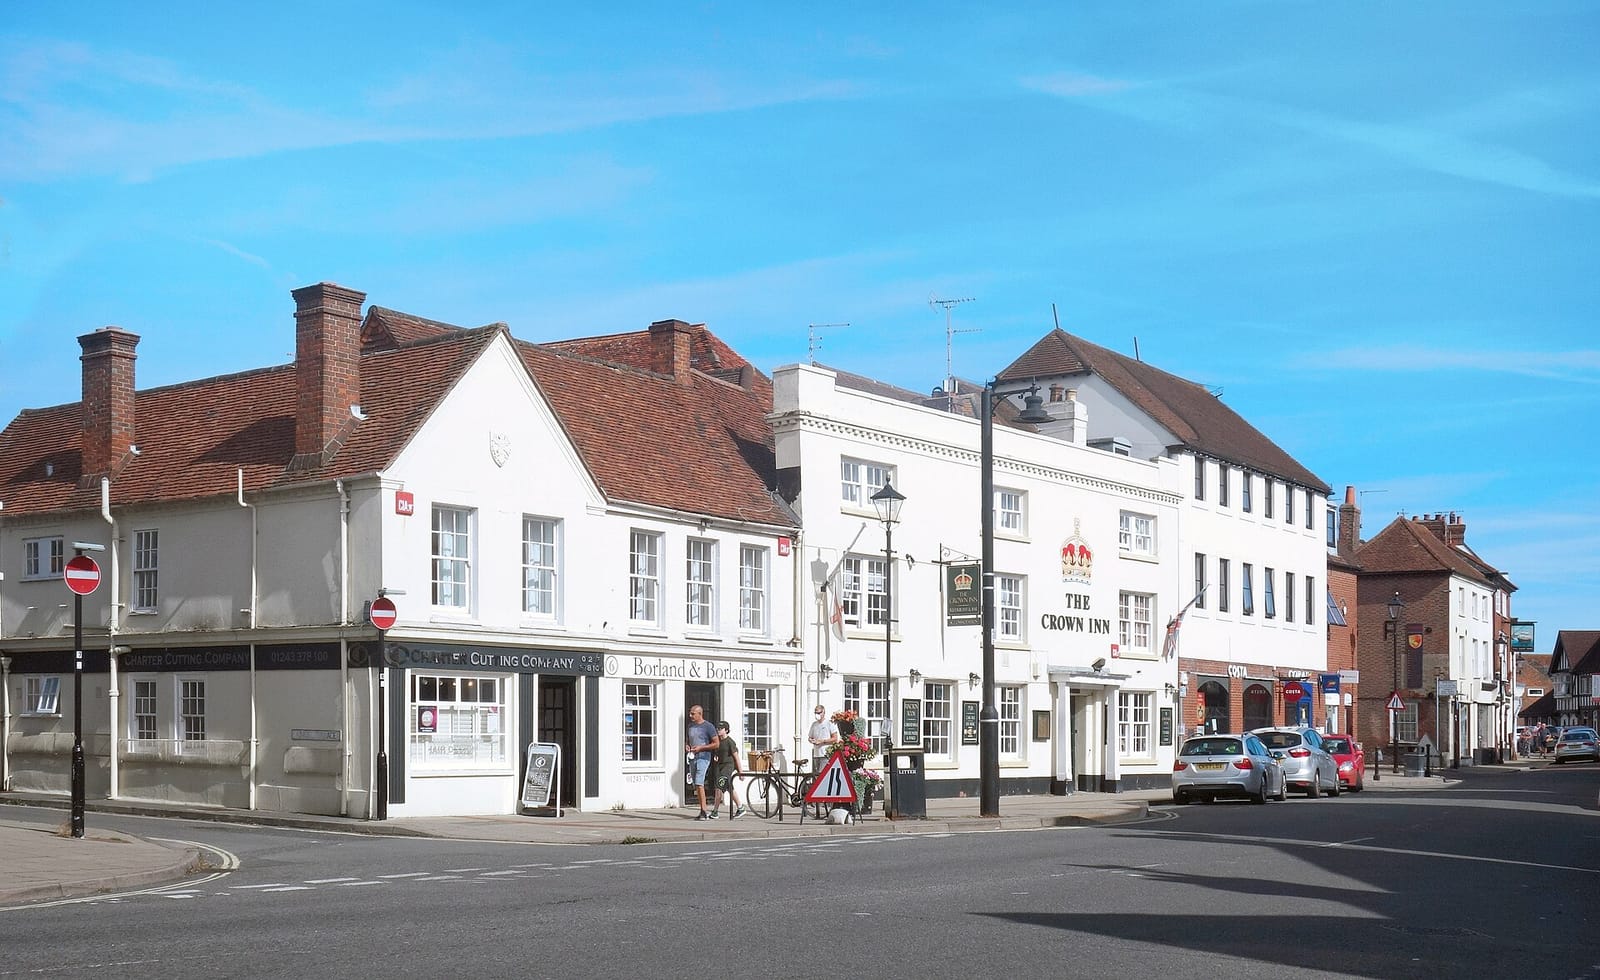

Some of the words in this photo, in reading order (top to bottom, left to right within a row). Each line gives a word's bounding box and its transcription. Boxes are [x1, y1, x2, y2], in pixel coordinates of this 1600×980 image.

[1065, 593, 1090, 610] THE
[1041, 613, 1084, 632] CROWN
[1088, 618, 1110, 634] INN
[124, 653, 163, 666] CHARTER
[164, 652, 202, 665] CUTTING
[204, 651, 250, 665] COMPANY
[521, 655, 574, 669] COMPANY
[633, 657, 685, 678] Borland
[689, 661, 701, 678] &
[706, 661, 754, 681] Borland
[766, 667, 792, 680] Lettings
[1228, 665, 1248, 679] COSTA
